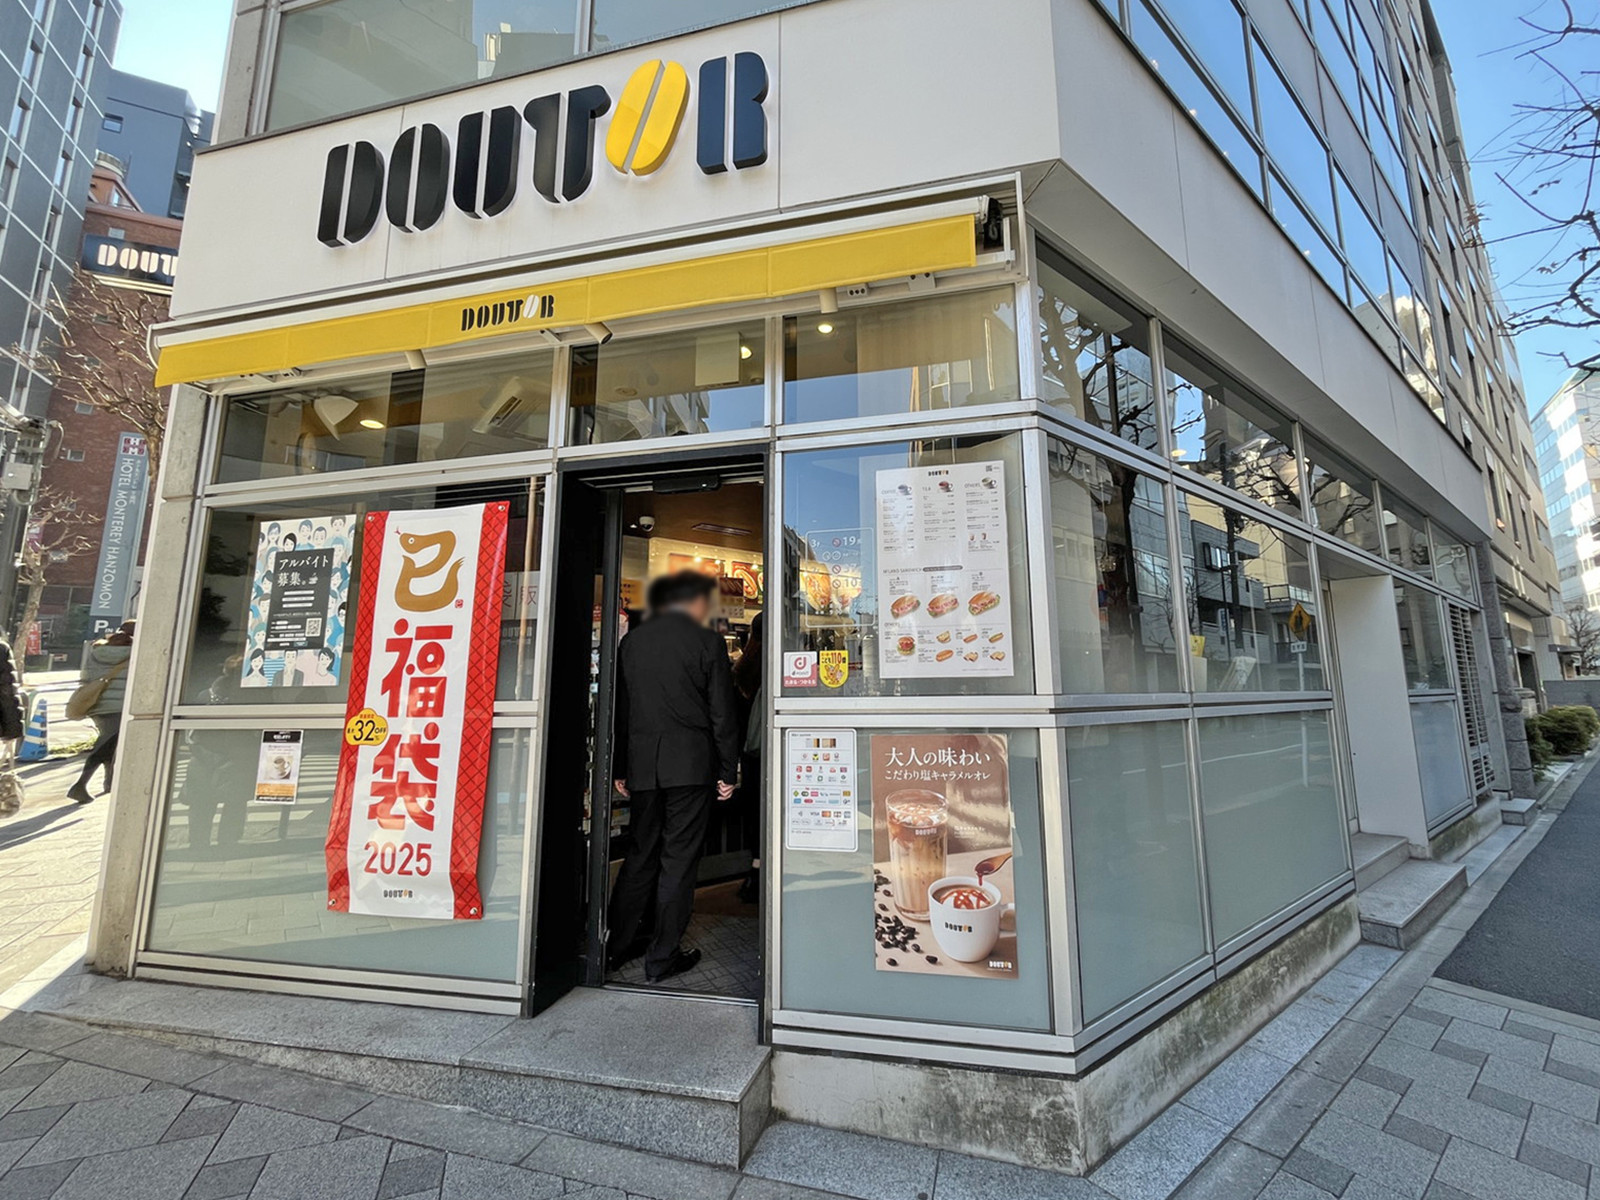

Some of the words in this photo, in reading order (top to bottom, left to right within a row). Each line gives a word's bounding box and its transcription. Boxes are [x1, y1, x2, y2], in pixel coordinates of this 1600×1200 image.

[317, 51, 769, 248] DOUTOR
[461, 294, 554, 331] DOUTOR
[118, 457, 134, 487] HOTEL
[109, 490, 128, 544] MONTEREY
[98, 546, 120, 609] HANZOMON
[279, 555, 329, 570] アルバイト
[93, 619, 109, 634] P
[353, 719, 376, 742] 32
[366, 618, 454, 832] 福袋
[885, 747, 991, 768] 大人の味わい
[884, 769, 992, 781] こだわり塩キャラメルオレ
[363, 840, 433, 877] 2025
